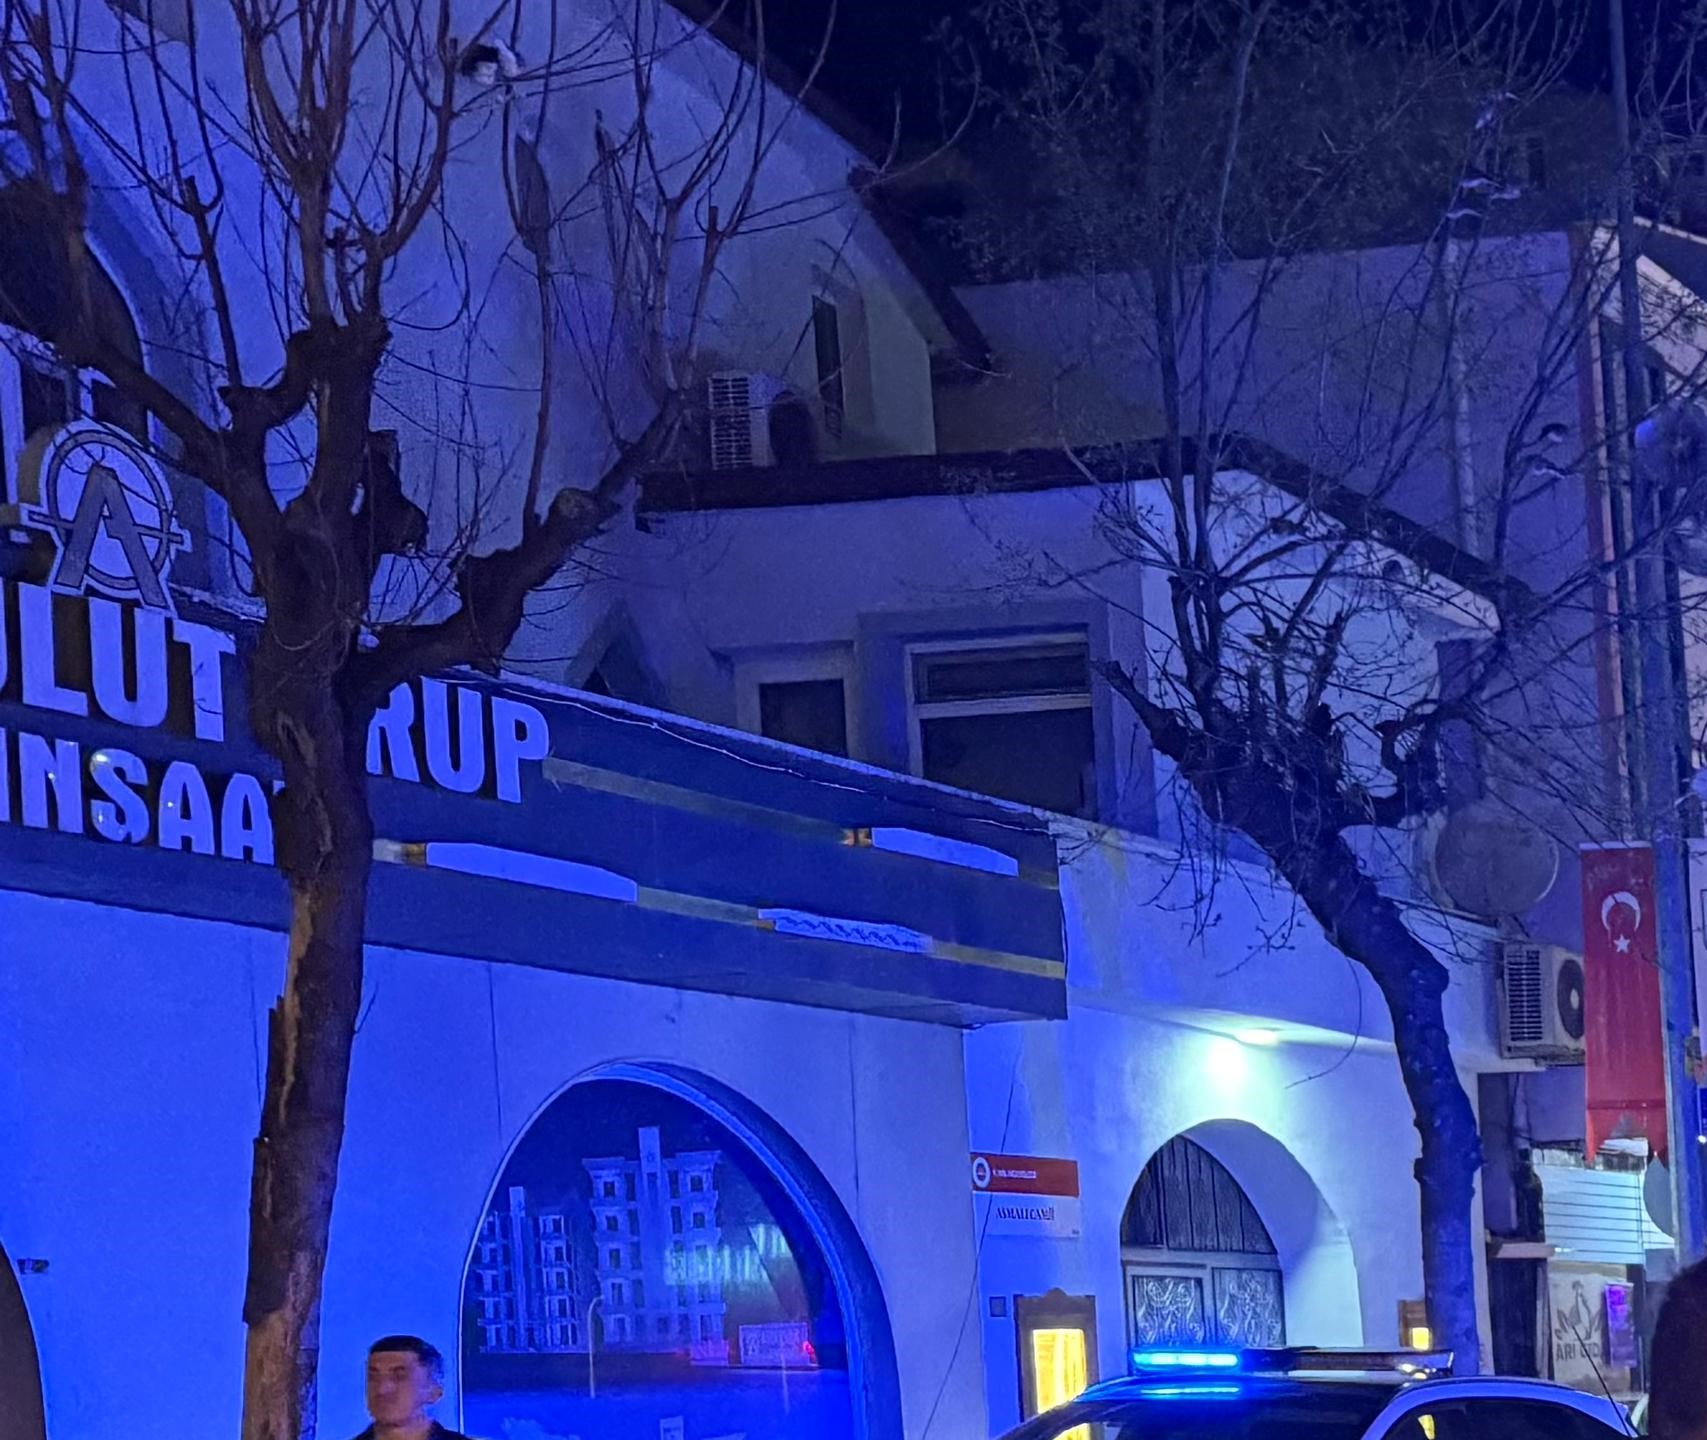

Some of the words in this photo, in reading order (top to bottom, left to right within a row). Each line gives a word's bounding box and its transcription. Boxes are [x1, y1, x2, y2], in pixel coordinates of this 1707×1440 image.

[0, 575, 236, 743] LUT
[364, 675, 550, 804] RUP
[0, 728, 286, 867] NSAA
